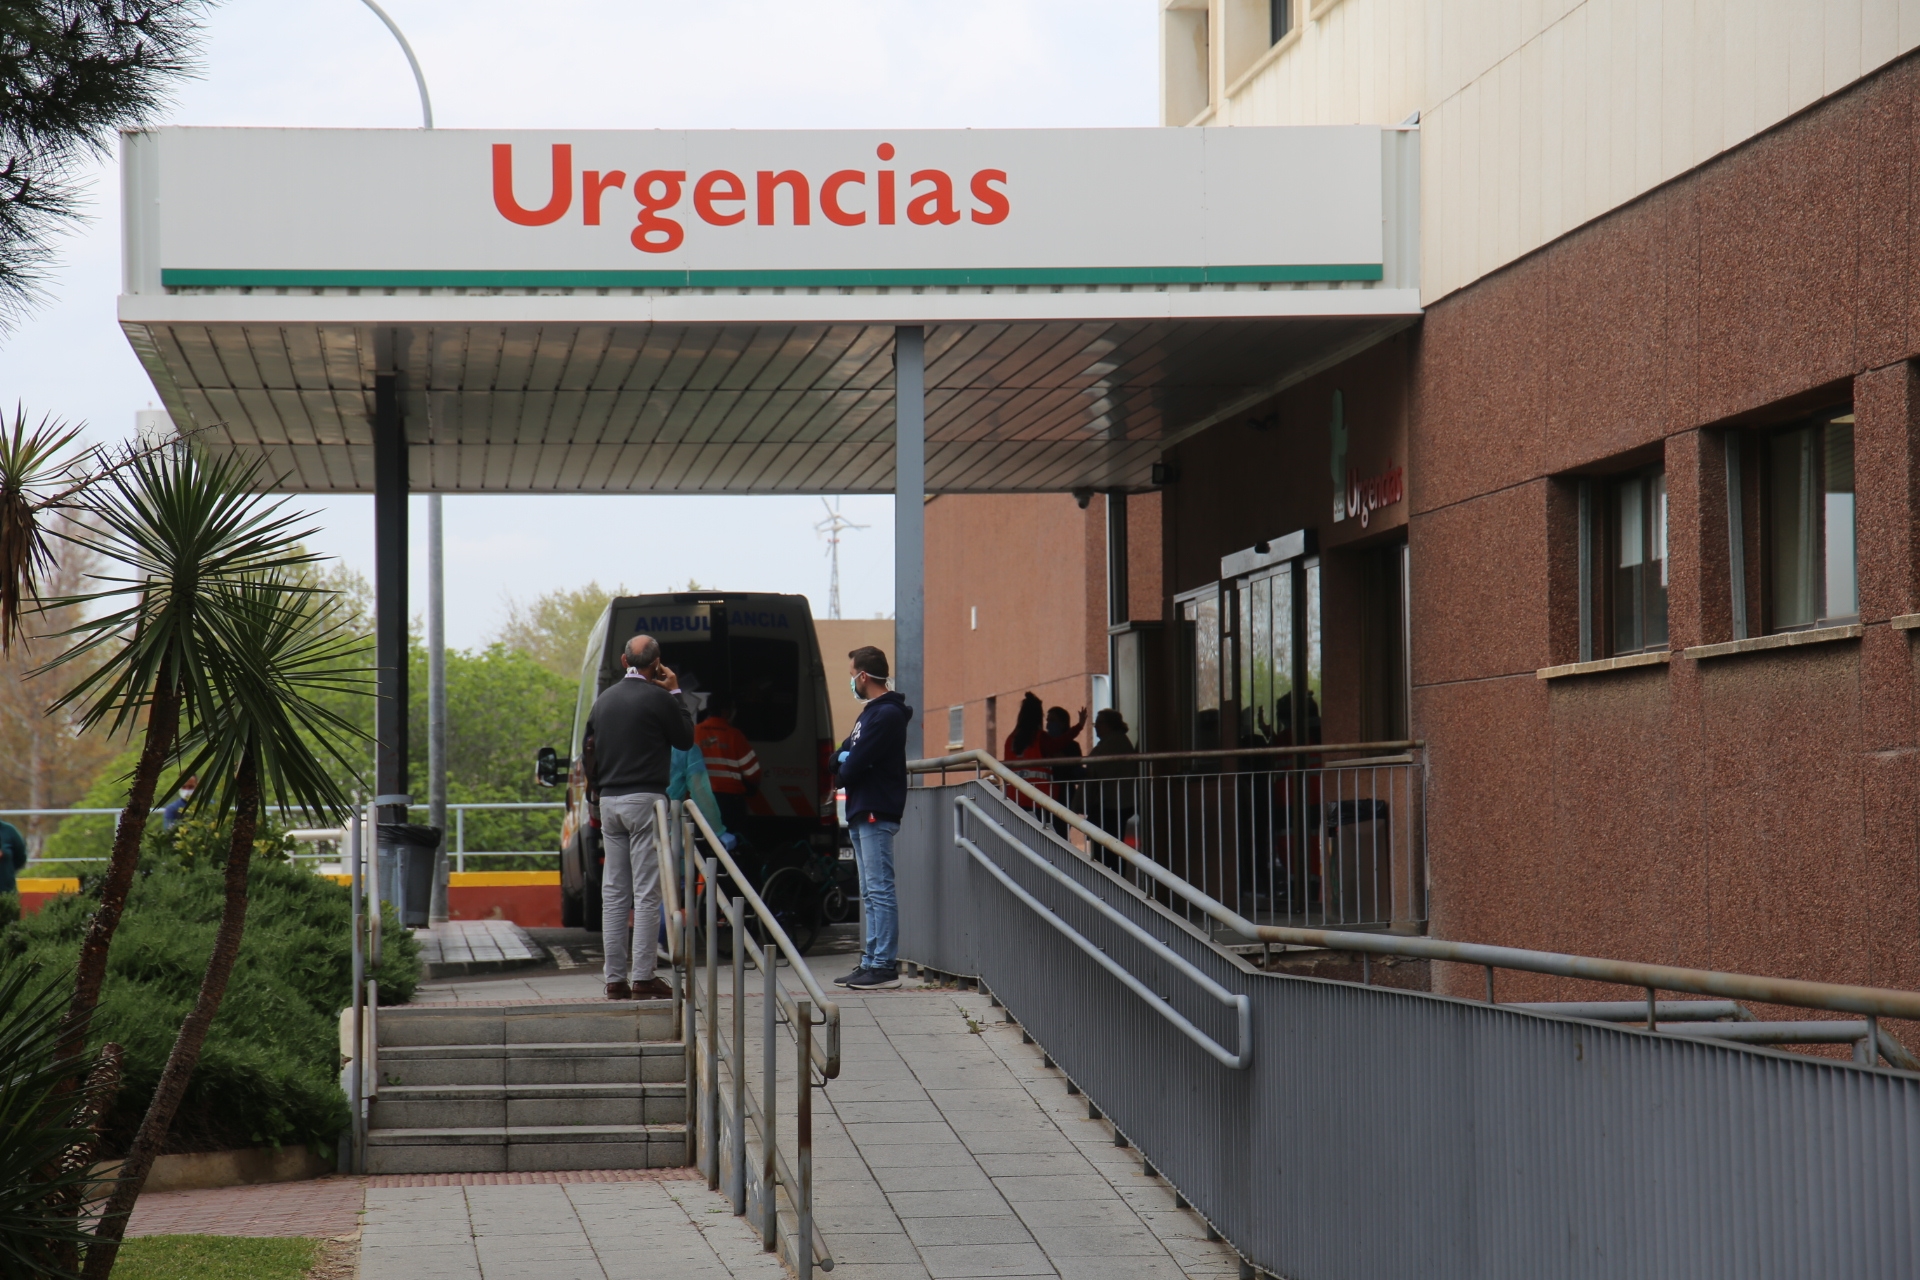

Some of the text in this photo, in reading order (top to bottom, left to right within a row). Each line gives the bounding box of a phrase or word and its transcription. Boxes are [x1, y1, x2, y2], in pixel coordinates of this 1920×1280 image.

[492, 142, 1010, 253] Urgencias
[1347, 458, 1403, 529] Urgencias
[635, 610, 789, 632] AMBULANCIA
